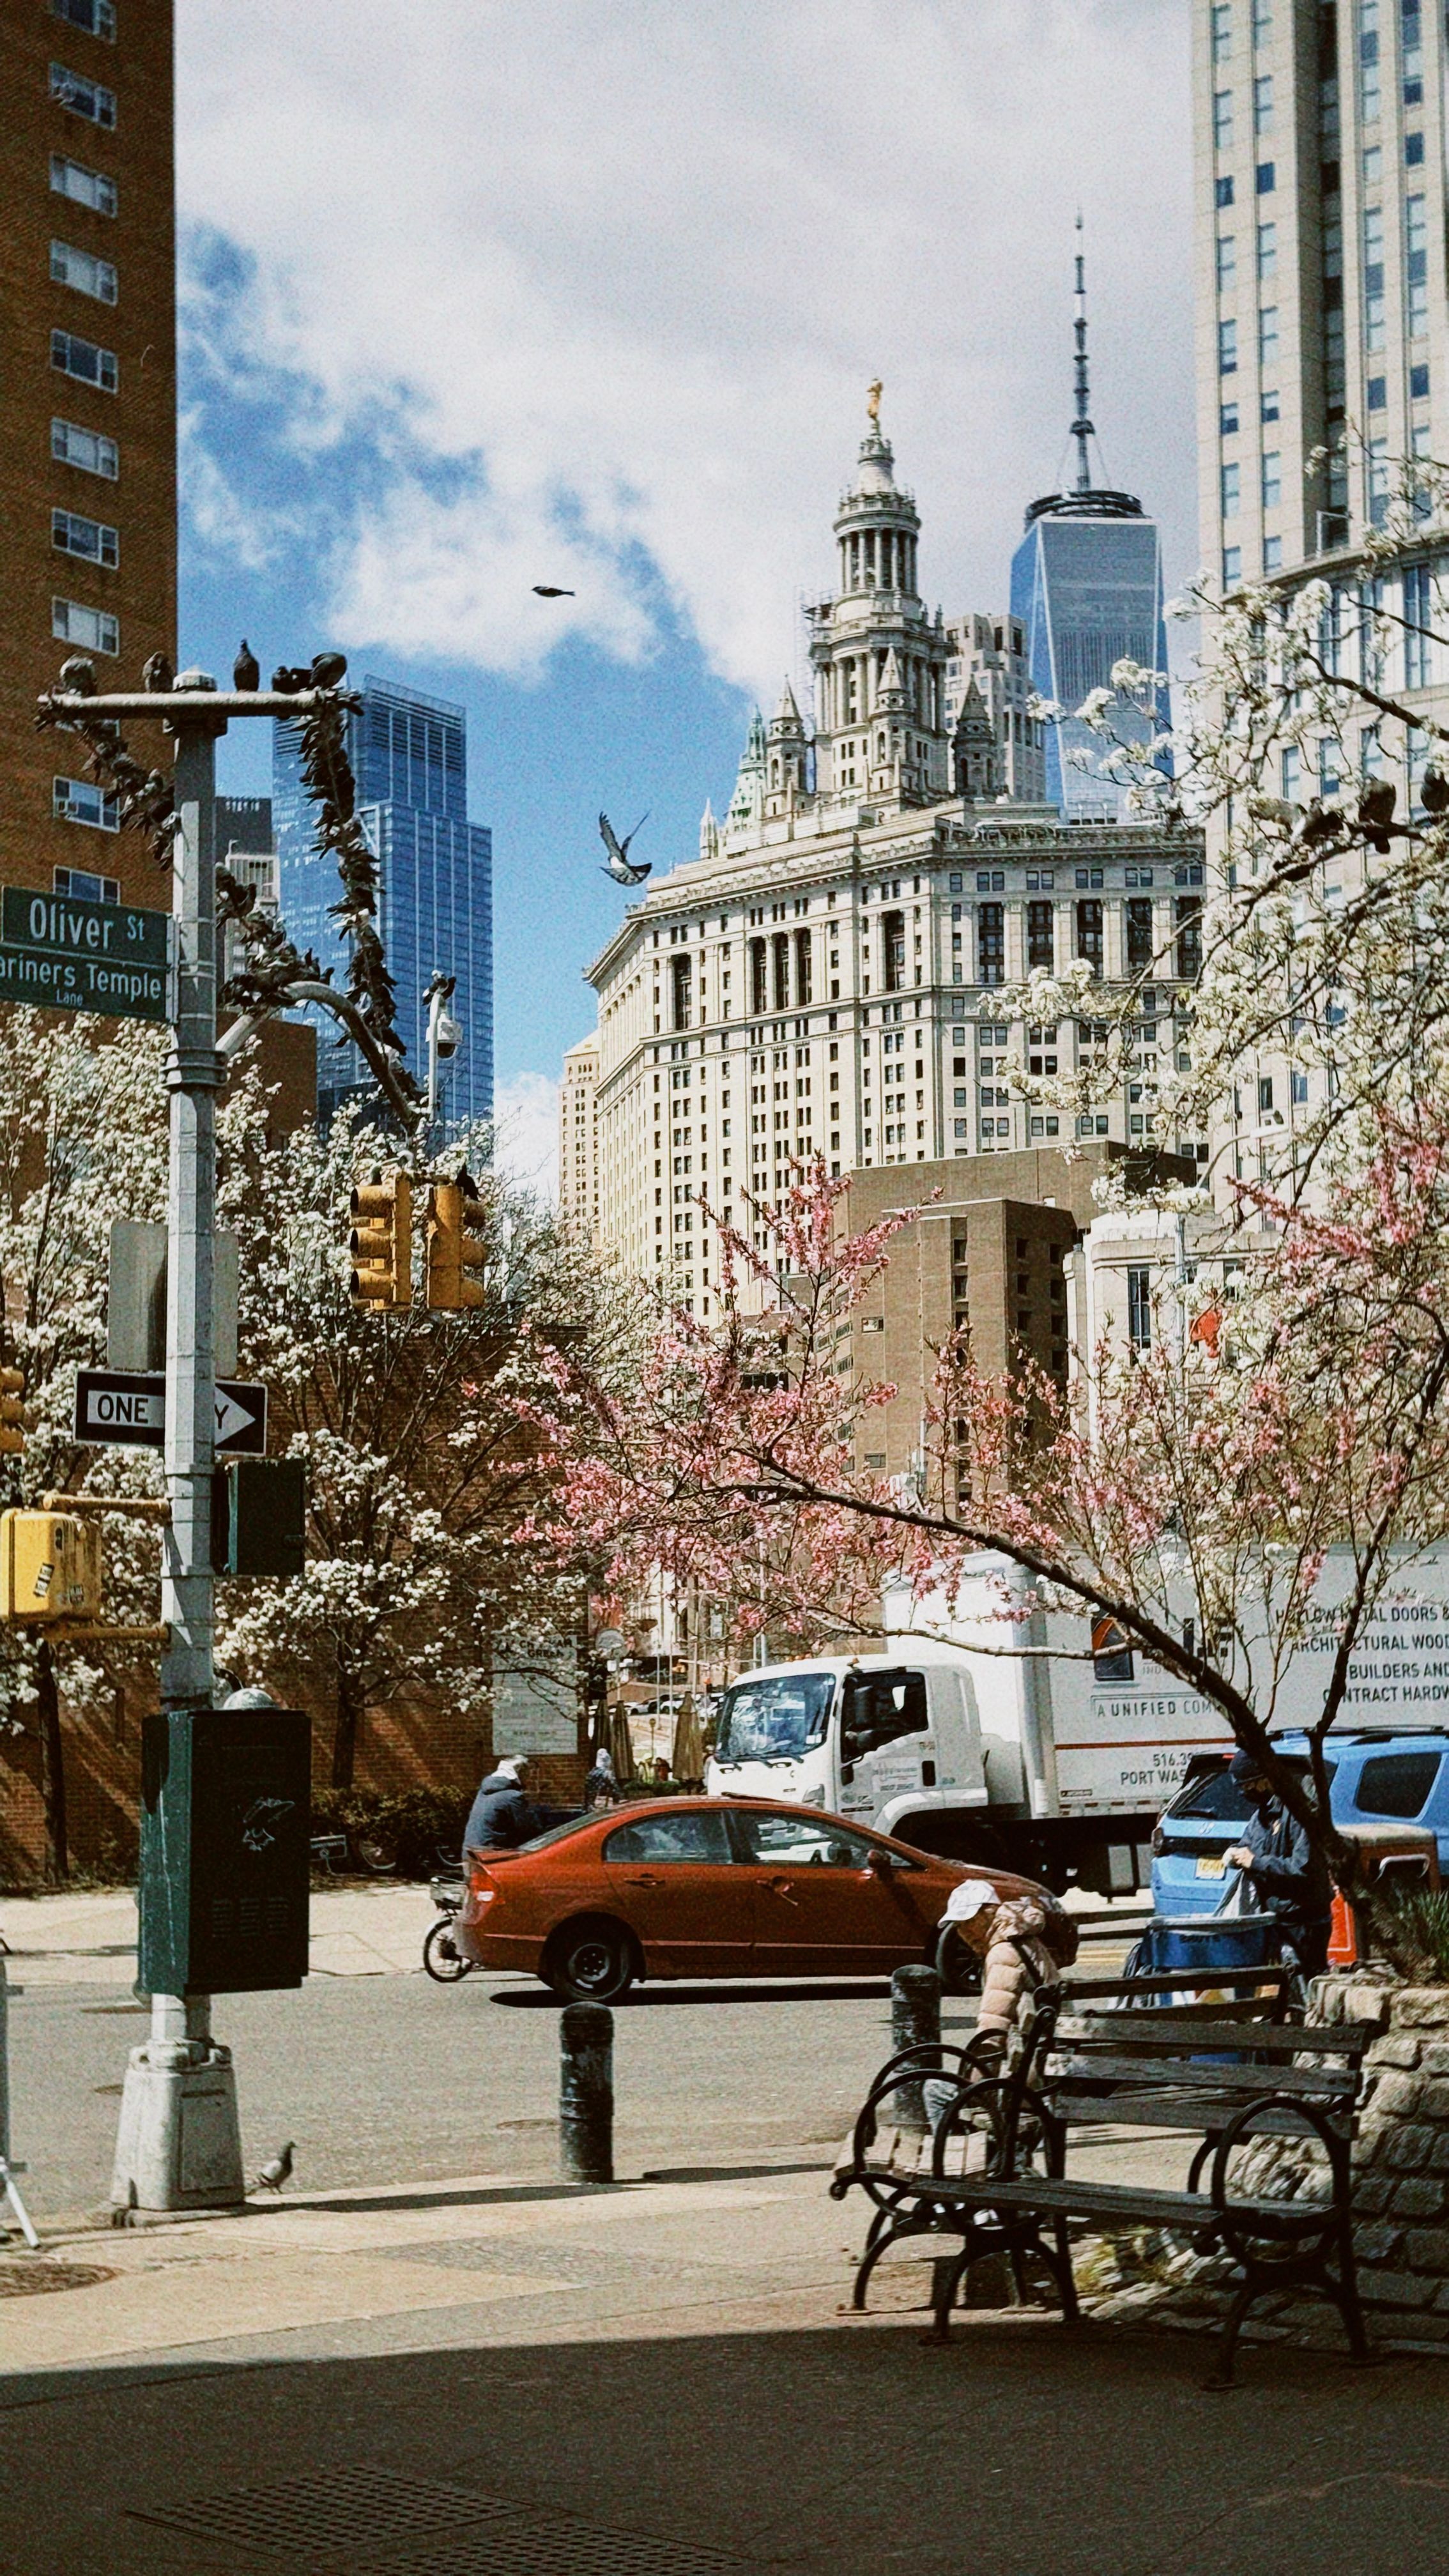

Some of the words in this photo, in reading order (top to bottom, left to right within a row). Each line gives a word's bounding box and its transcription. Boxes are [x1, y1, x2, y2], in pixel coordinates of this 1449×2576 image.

[30, 898, 114, 950] Oliver
[127, 915, 146, 941] St
[86, 963, 162, 1002] Temple
[56, 989, 83, 1007] Lane
[97, 1394, 149, 1424] ONE
[1341, 1607, 1388, 1623] MTAL
[1392, 1606, 1438, 1622] DOORS
[1291, 1634, 1409, 1652] ARCHITCTURAL
[1349, 1662, 1420, 1680] BUILDERS
[1322, 1686, 1398, 1704] CNTRACT
[1098, 1704, 1106, 1718] A
[1110, 1701, 1176, 1717] UNIFIED
[1121, 1770, 1154, 1785] PORT
